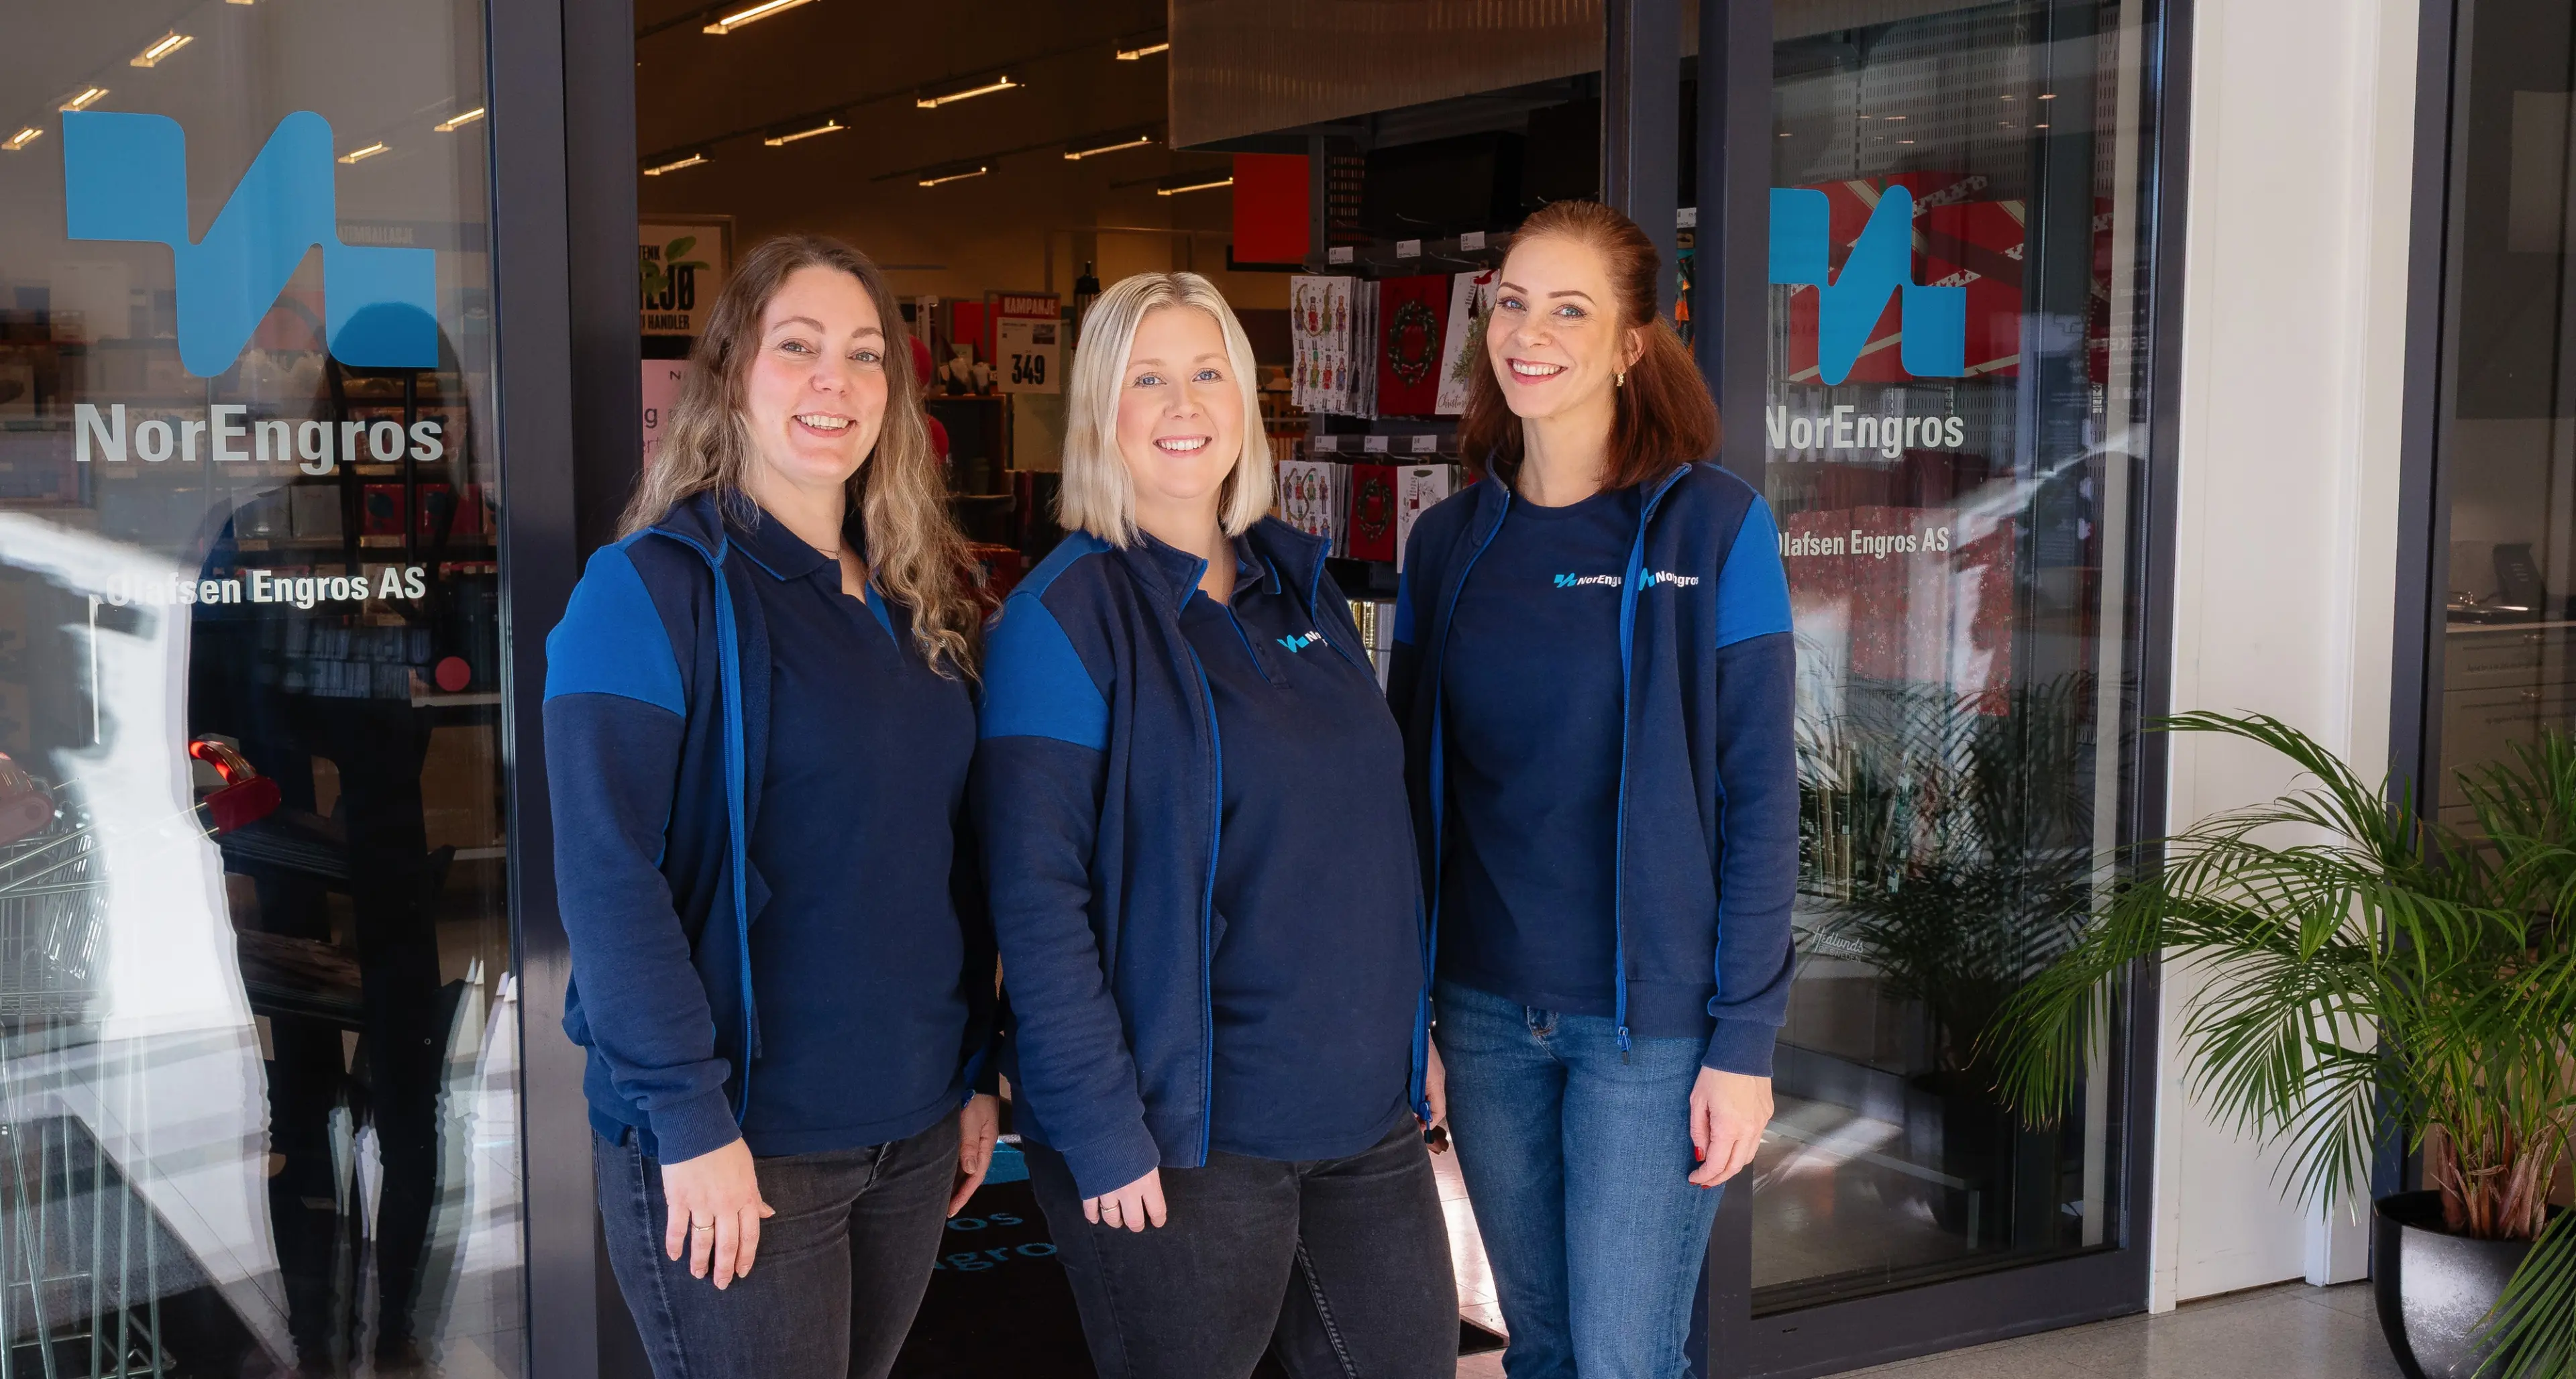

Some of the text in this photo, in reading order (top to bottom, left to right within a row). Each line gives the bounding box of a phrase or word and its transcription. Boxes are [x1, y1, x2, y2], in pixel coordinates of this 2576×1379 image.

[1004, 297, 1055, 315] KAMPANJE
[648, 315, 690, 329] HANDLER
[1012, 354, 1044, 384] 349
[74, 404, 443, 475] NorEngros
[1766, 405, 1964, 458] NorEngros
[1778, 527, 1949, 559] lafsen Engros AS
[106, 567, 425, 609] Olafsen Engros AS
[1812, 925, 1864, 953] Hedlunds
[1829, 948, 1862, 963] SWEDEN
